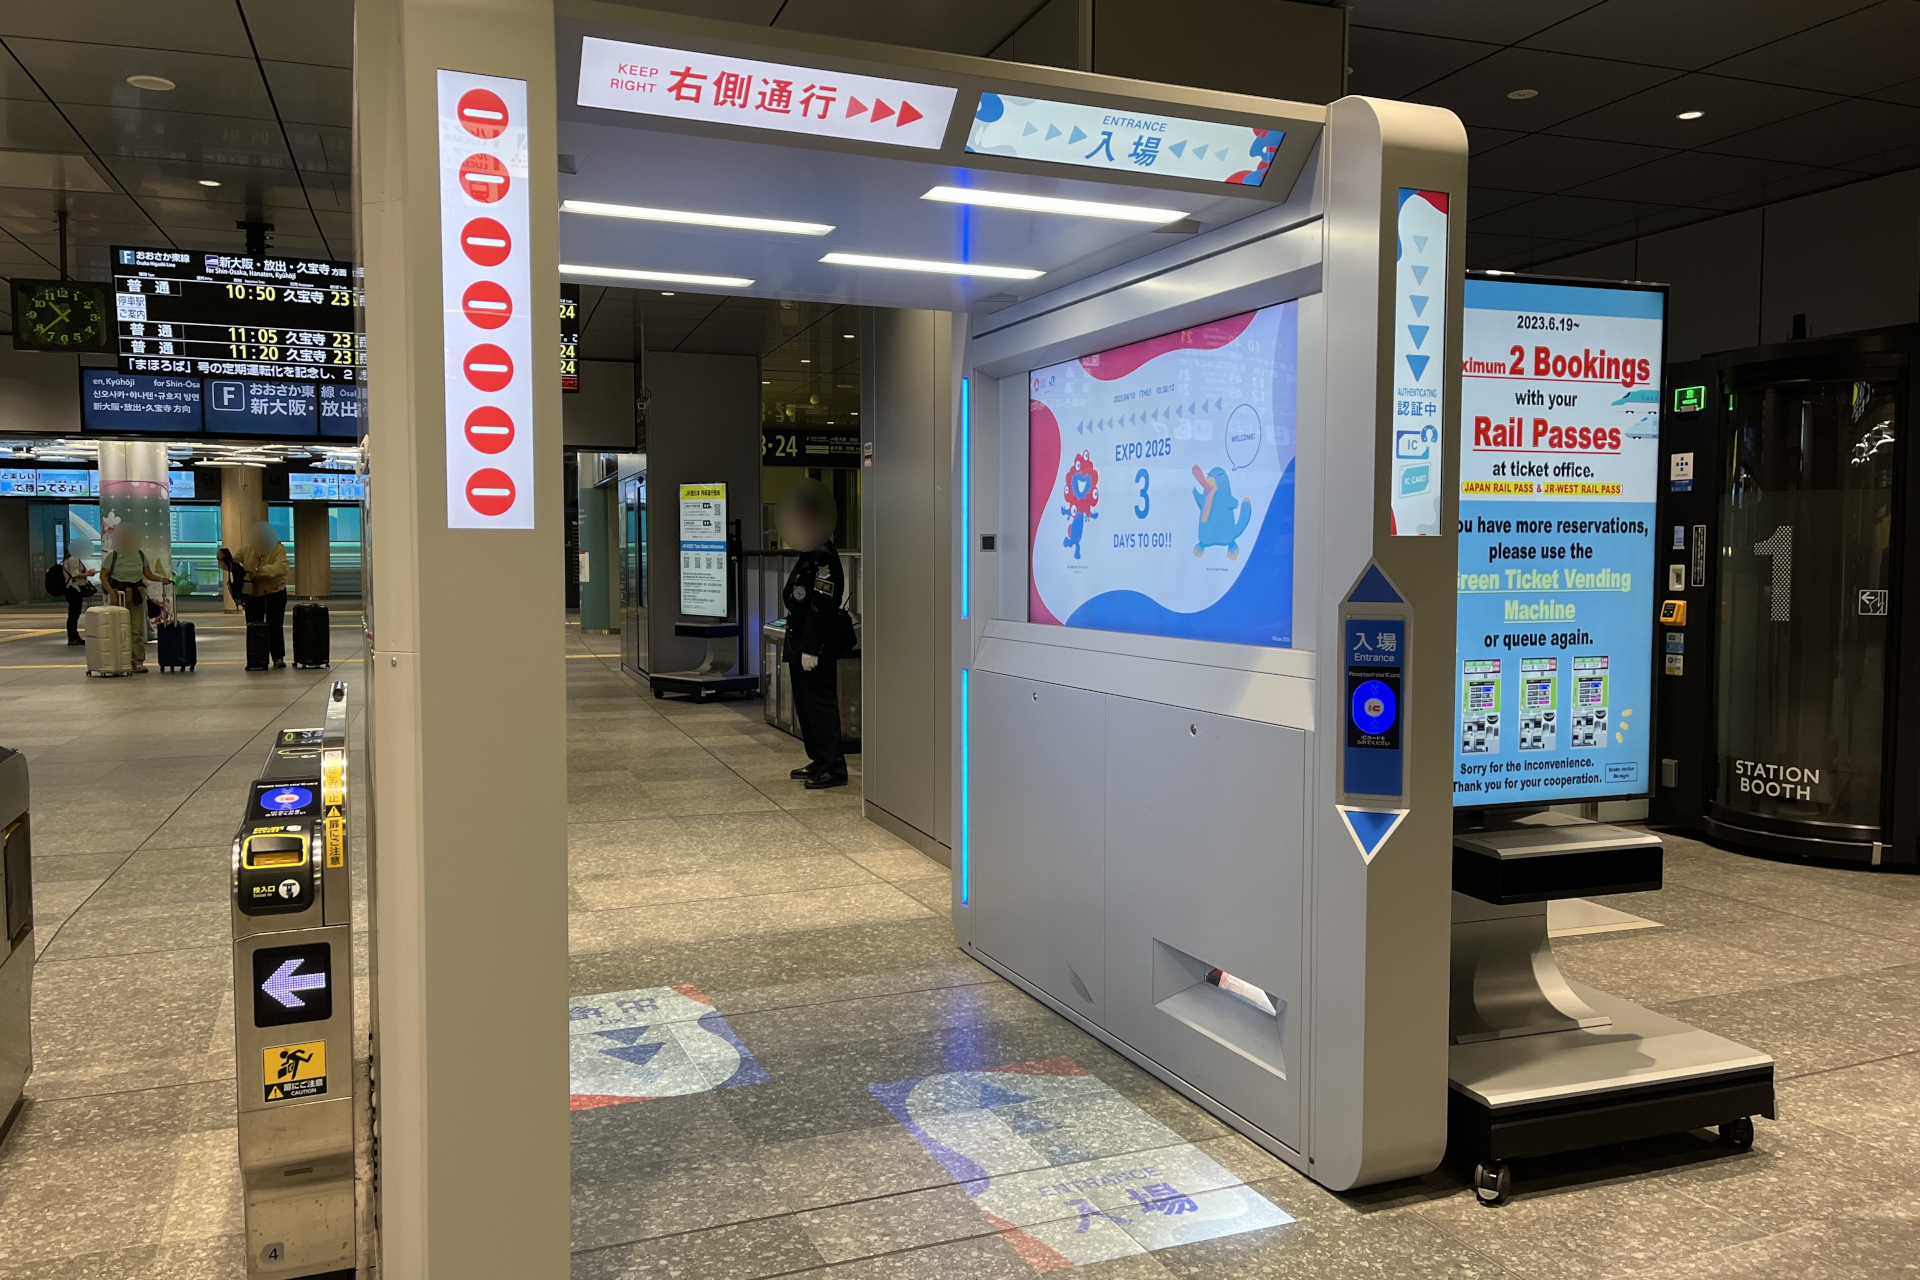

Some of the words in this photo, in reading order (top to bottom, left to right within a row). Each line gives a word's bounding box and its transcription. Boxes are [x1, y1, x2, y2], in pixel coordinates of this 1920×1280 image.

[617, 62, 659, 79] KEEP
[610, 78, 657, 94] RIGHT
[666, 66, 837, 120] 右側通行
[1102, 114, 1168, 133] ENTRANCE
[1085, 131, 1161, 167] 入場
[123, 251, 132, 264] F
[136, 251, 191, 263] おおさか東線
[331, 268, 347, 277] 方面
[45, 292, 55, 300] 11
[57, 290, 68, 298] 12
[73, 293, 78, 301] 1
[118, 295, 145, 306] 停車駅
[226, 284, 276, 301] 10:50
[283, 288, 324, 304] 久宝寺
[331, 291, 350, 306] 23
[34, 300, 46, 308] 10
[83, 301, 91, 309] 2
[560, 305, 575, 319] 24
[29, 311, 37, 319] 9
[119, 308, 146, 319] ご案内
[36, 324, 43, 332] 8
[47, 332, 55, 340] 7
[229, 327, 278, 344] 11:05
[285, 331, 326, 346] 久宝寺
[333, 333, 351, 348] 23
[229, 344, 279, 360] 11:20
[286, 348, 327, 363] 久宝寺
[333, 350, 352, 365] 23
[560, 345, 575, 358] 24
[560, 360, 575, 374] 24
[1509, 344, 1525, 375] 2
[1534, 346, 1650, 388] Bookings
[154, 379, 165, 387] for
[183, 393, 200, 401] 방면
[223, 387, 235, 405] F
[1397, 388, 1437, 398] AUTHENTICATING
[1515, 389, 1544, 406] with
[1549, 395, 1577, 410] your
[173, 404, 191, 413] 方向
[1397, 401, 1436, 417] 認証中
[1231, 432, 1256, 443] WELCOME!
[1474, 416, 1523, 447] Rail
[1532, 417, 1621, 450] Passes
[1115, 442, 1143, 462] EXPO
[1145, 437, 1171, 458] 2025
[1407, 439, 1418, 450] IC
[1493, 463, 1506, 476] at
[1511, 461, 1549, 477] ticket
[1553, 462, 1594, 478] office.
[1411, 475, 1426, 484] CARD
[1134, 468, 1150, 519] 3
[1493, 483, 1511, 493] RAIL
[1513, 484, 1534, 493] PASS
[1536, 484, 1542, 493] &
[1544, 484, 1578, 493] JR-WEST
[1581, 485, 1599, 493] RAIL
[1477, 516, 1511, 533] have
[1516, 520, 1552, 533] more
[1557, 517, 1649, 537] reservations,
[1113, 533, 1136, 549] DAYS
[1138, 533, 1150, 548] TO
[1151, 532, 1172, 548] GO!!
[1489, 542, 1536, 563] please
[1541, 546, 1566, 559] use
[1570, 542, 1593, 559] the
[1457, 571, 1500, 590] reen
[1505, 568, 1559, 590] Ticket
[1564, 568, 1631, 593] Vending
[1753, 525, 1793, 621] 1
[1504, 599, 1576, 620] Machine
[1353, 632, 1397, 652] 入場
[1484, 634, 1499, 647] or
[1503, 633, 1546, 650] queue
[1550, 628, 1594, 650] again.
[1354, 652, 1395, 663] Entrance
[1460, 763, 1487, 777] Sorry
[1490, 761, 1503, 773] for
[1506, 761, 1521, 772] the
[1524, 757, 1594, 772] inconvenience.
[1735, 759, 1820, 784] STATION
[1453, 781, 1482, 793] Thank
[1485, 781, 1502, 794] you
[1504, 779, 1518, 790] for
[1520, 778, 1541, 791] your
[1544, 773, 1602, 790] cooperation.
[1740, 776, 1811, 801] BOOTH
[329, 820, 340, 865] 扉にご注意
[283, 1079, 323, 1091] 扉にご注意
[291, 1088, 317, 1096] CAUTION
[1037, 1167, 1163, 1197] ENTRANCE
[1064, 1182, 1198, 1234] 入場
[268, 1249, 278, 1261] 4
